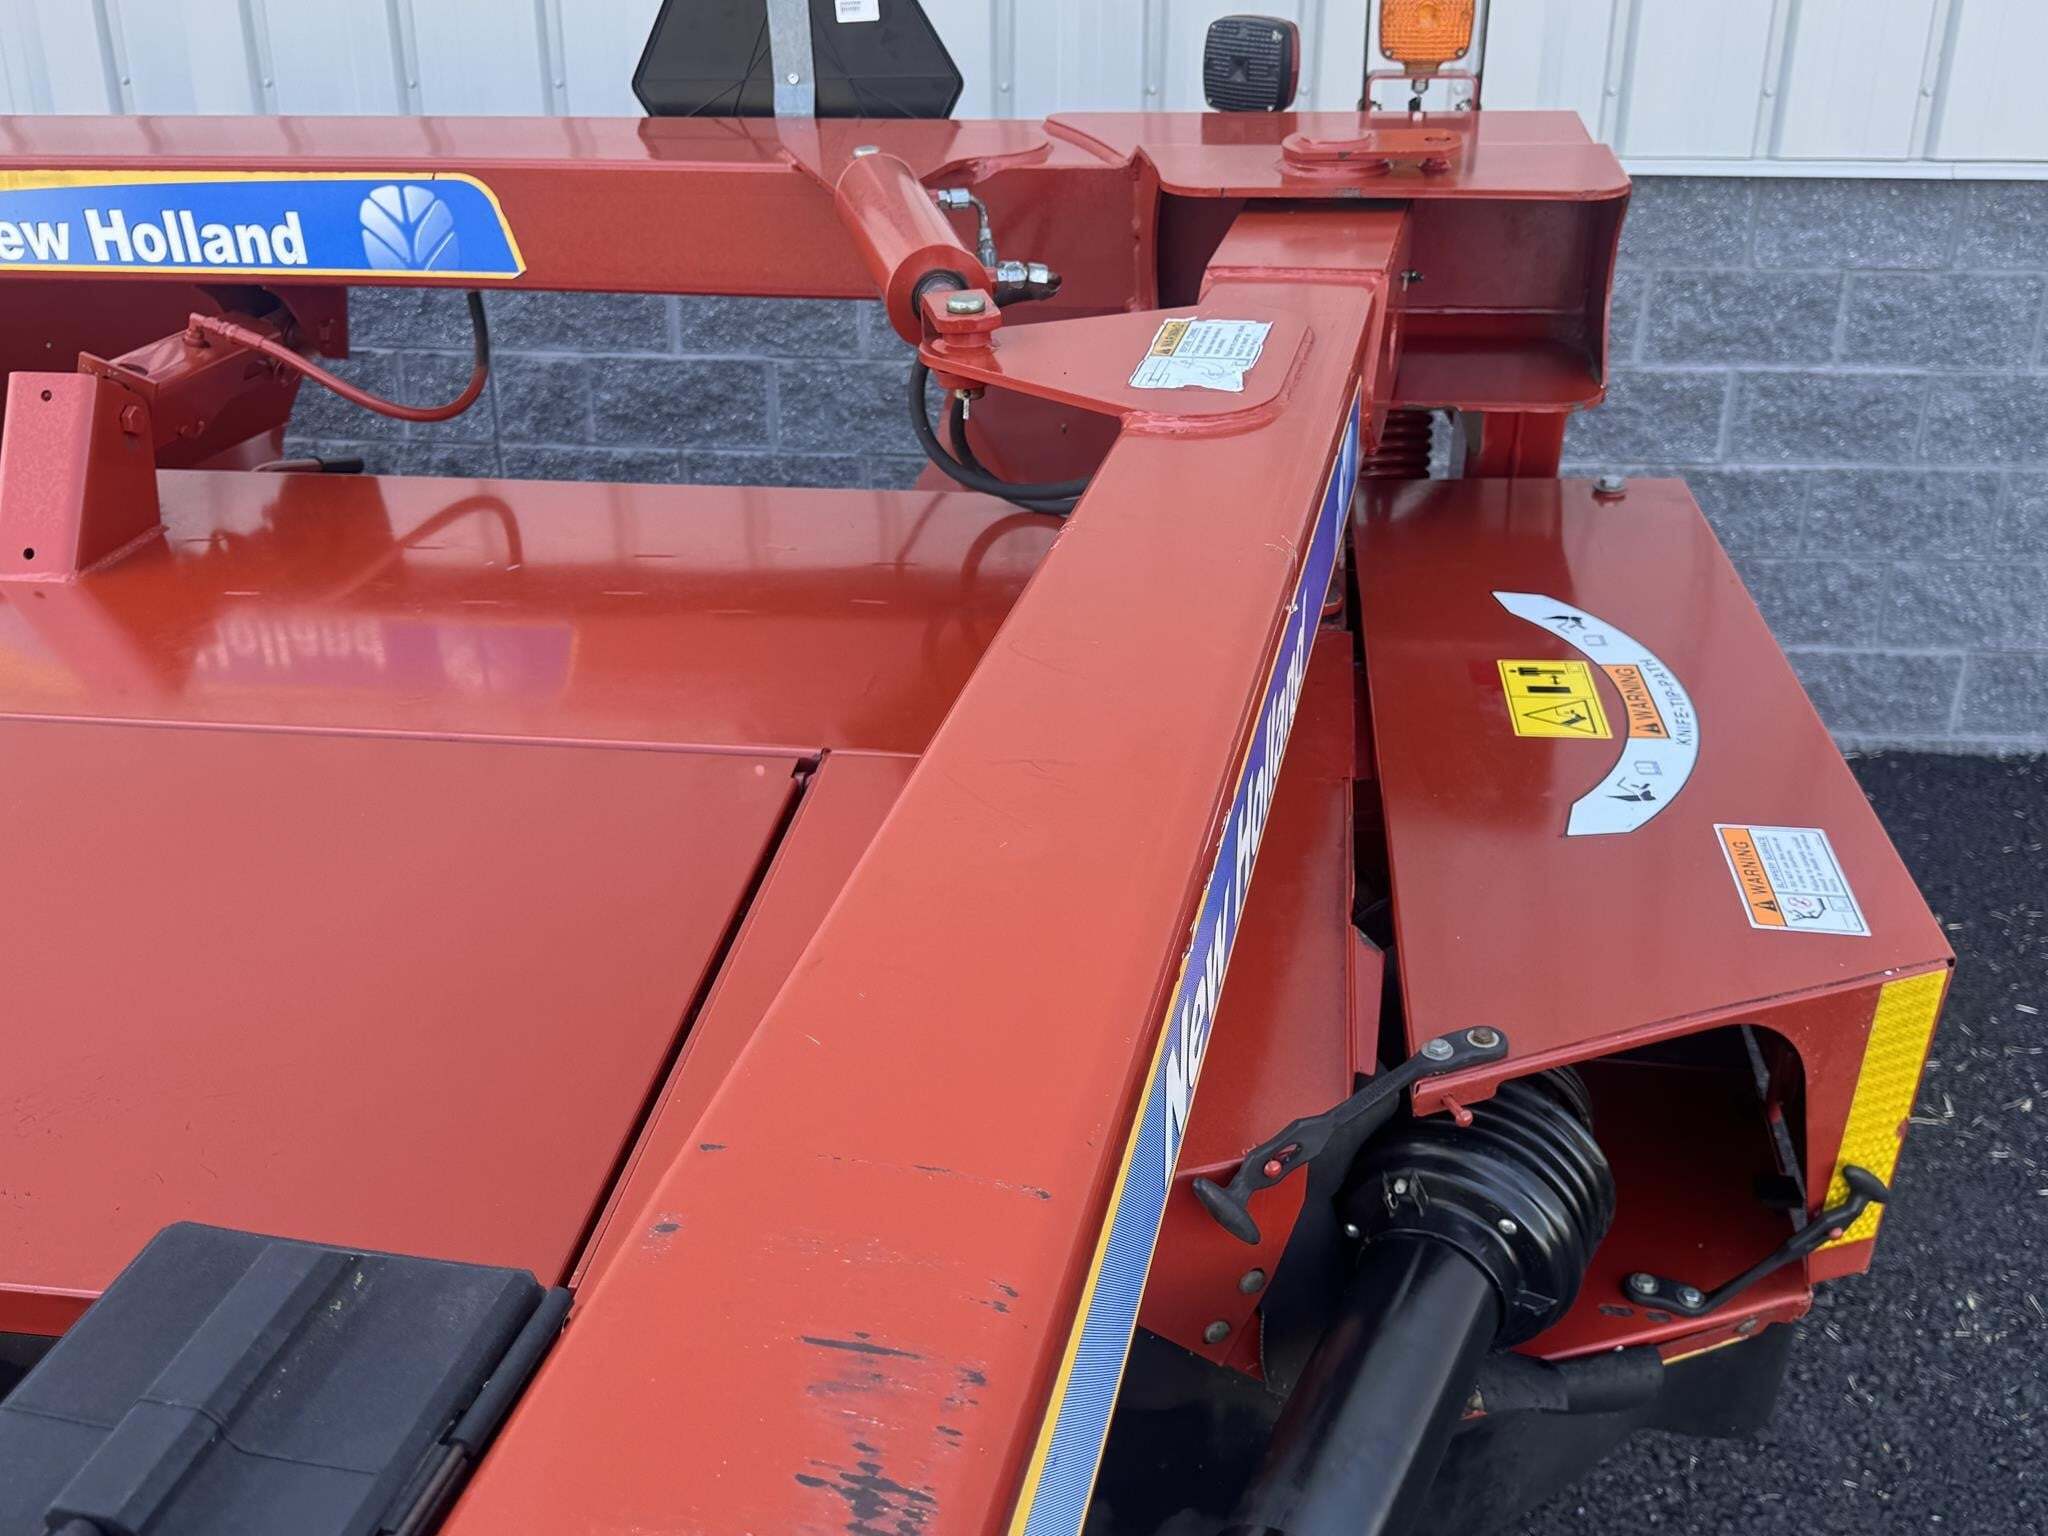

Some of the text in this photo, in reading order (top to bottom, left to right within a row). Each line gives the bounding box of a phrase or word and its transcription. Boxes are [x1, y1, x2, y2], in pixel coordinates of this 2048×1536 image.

[84, 208, 309, 265] Holland
[1615, 668, 1655, 721] WARNING
[1165, 588, 1308, 1189] New Holland
[1732, 841, 1767, 895] WARNING
